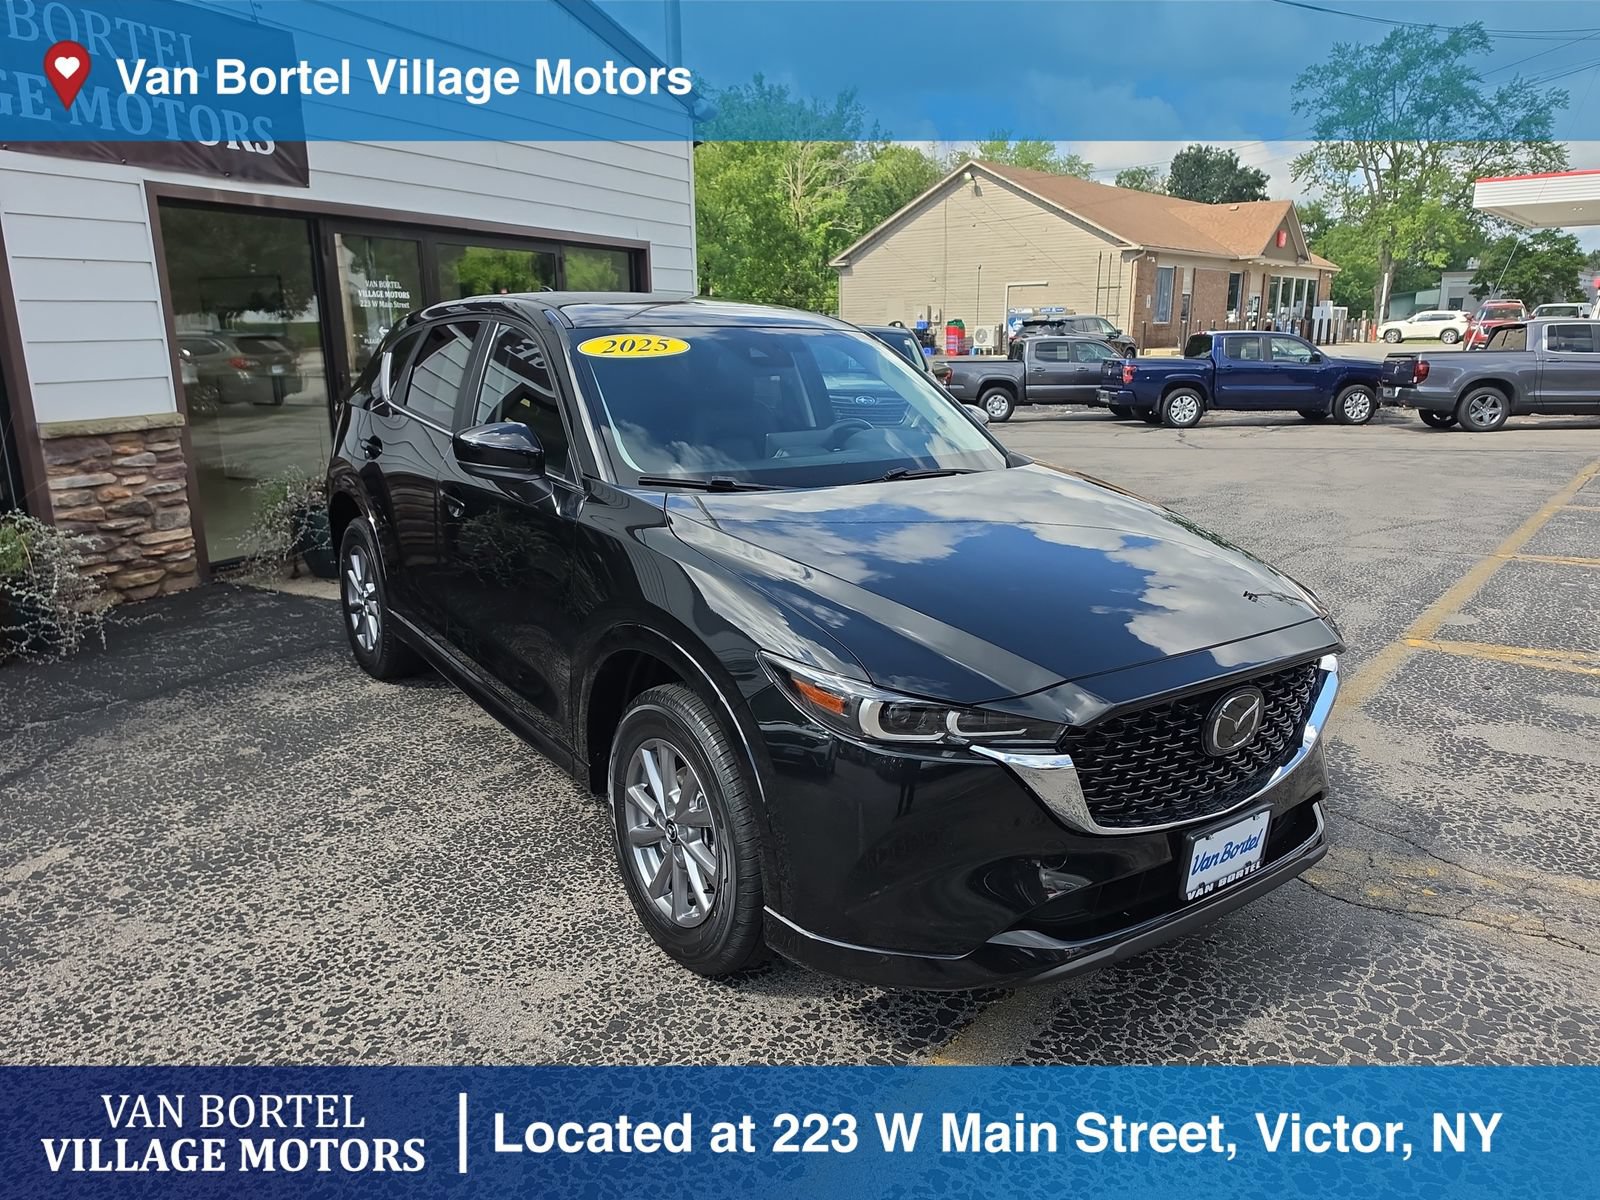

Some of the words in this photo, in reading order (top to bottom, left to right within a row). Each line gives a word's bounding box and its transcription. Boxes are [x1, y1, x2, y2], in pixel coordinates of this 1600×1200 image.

[70, 85, 276, 155] MOTORS
[365, 280, 378, 288] VAN
[379, 281, 402, 289] BORTEL
[359, 289, 384, 298] VILLAGE
[385, 291, 410, 299] MOTORS
[360, 299, 371, 308] 223
[379, 300, 393, 308] Main
[393, 301, 410, 309] Street
[601, 338, 670, 354] 2025
[1191, 851, 1220, 876] Van
[1219, 828, 1263, 864] Bortel
[1187, 884, 1213, 901] VAN
[1217, 861, 1261, 888] BORTEL
